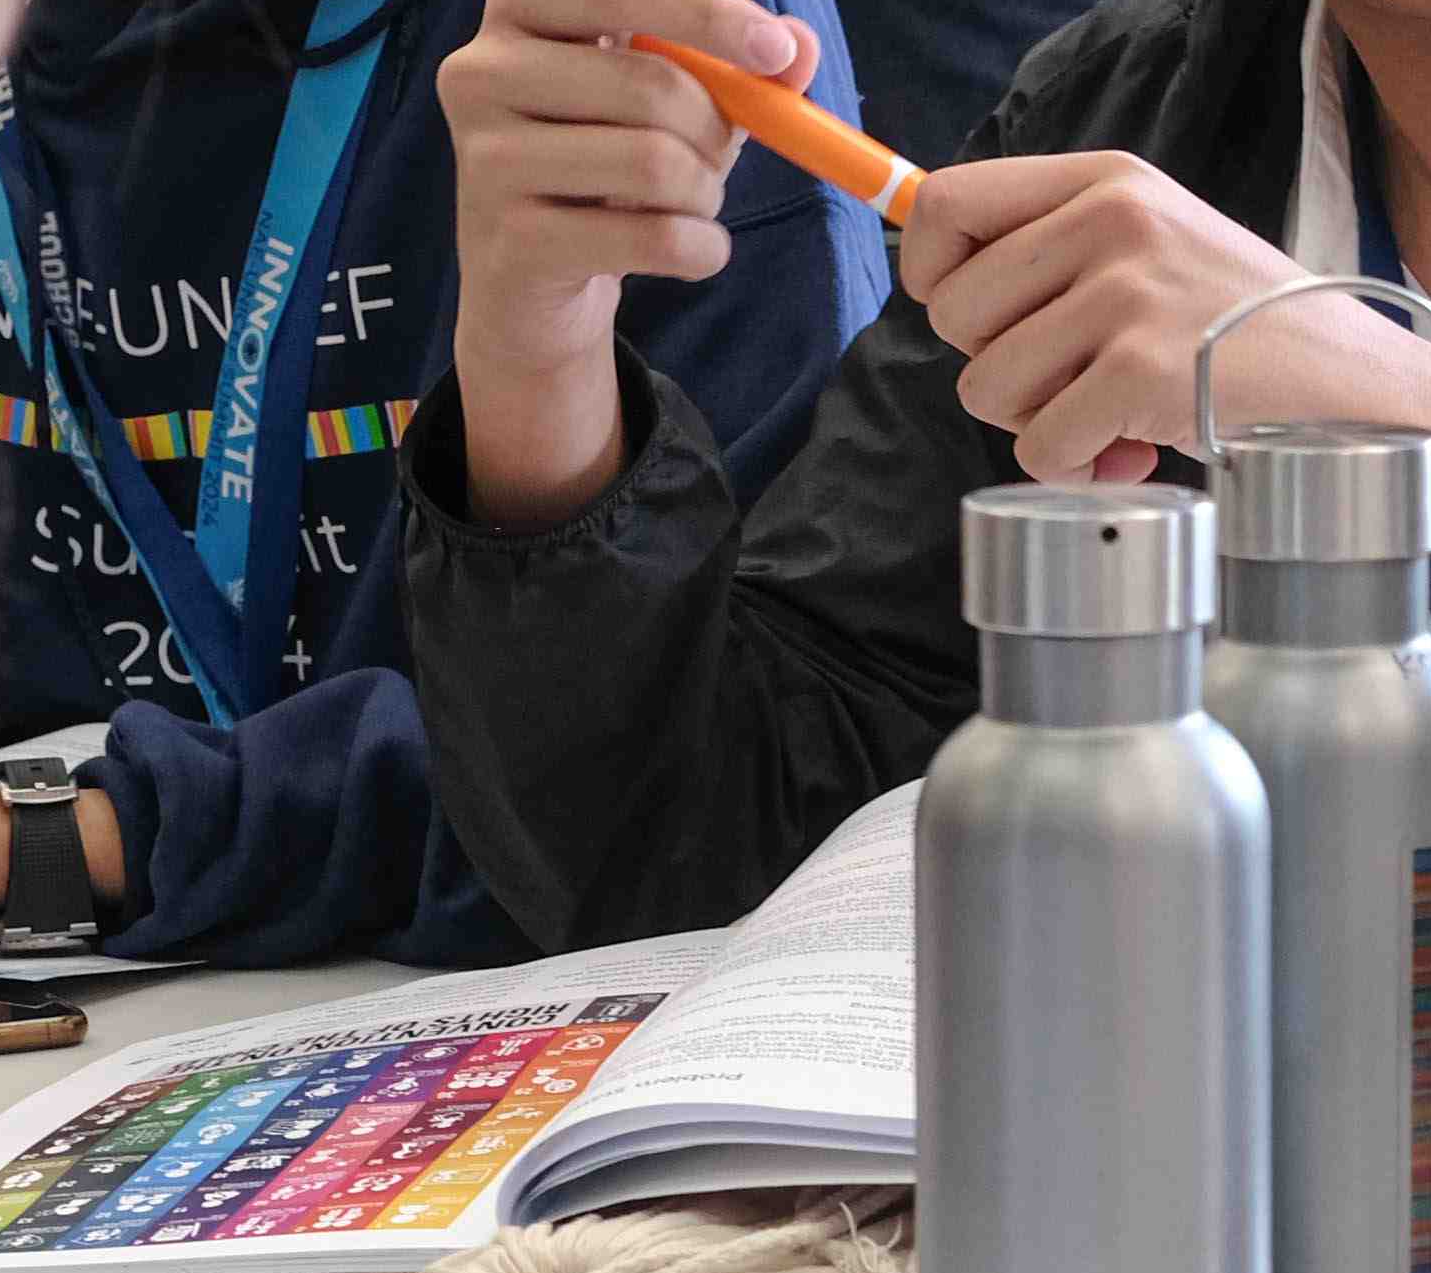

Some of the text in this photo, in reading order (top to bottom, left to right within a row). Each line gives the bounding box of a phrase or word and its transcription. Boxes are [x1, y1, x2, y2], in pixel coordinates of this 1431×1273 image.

[221, 237, 295, 503] INNOVATE
[304, 1014, 557, 1053] CONVENTION
[433, 1004, 572, 1025] RIGHTS
